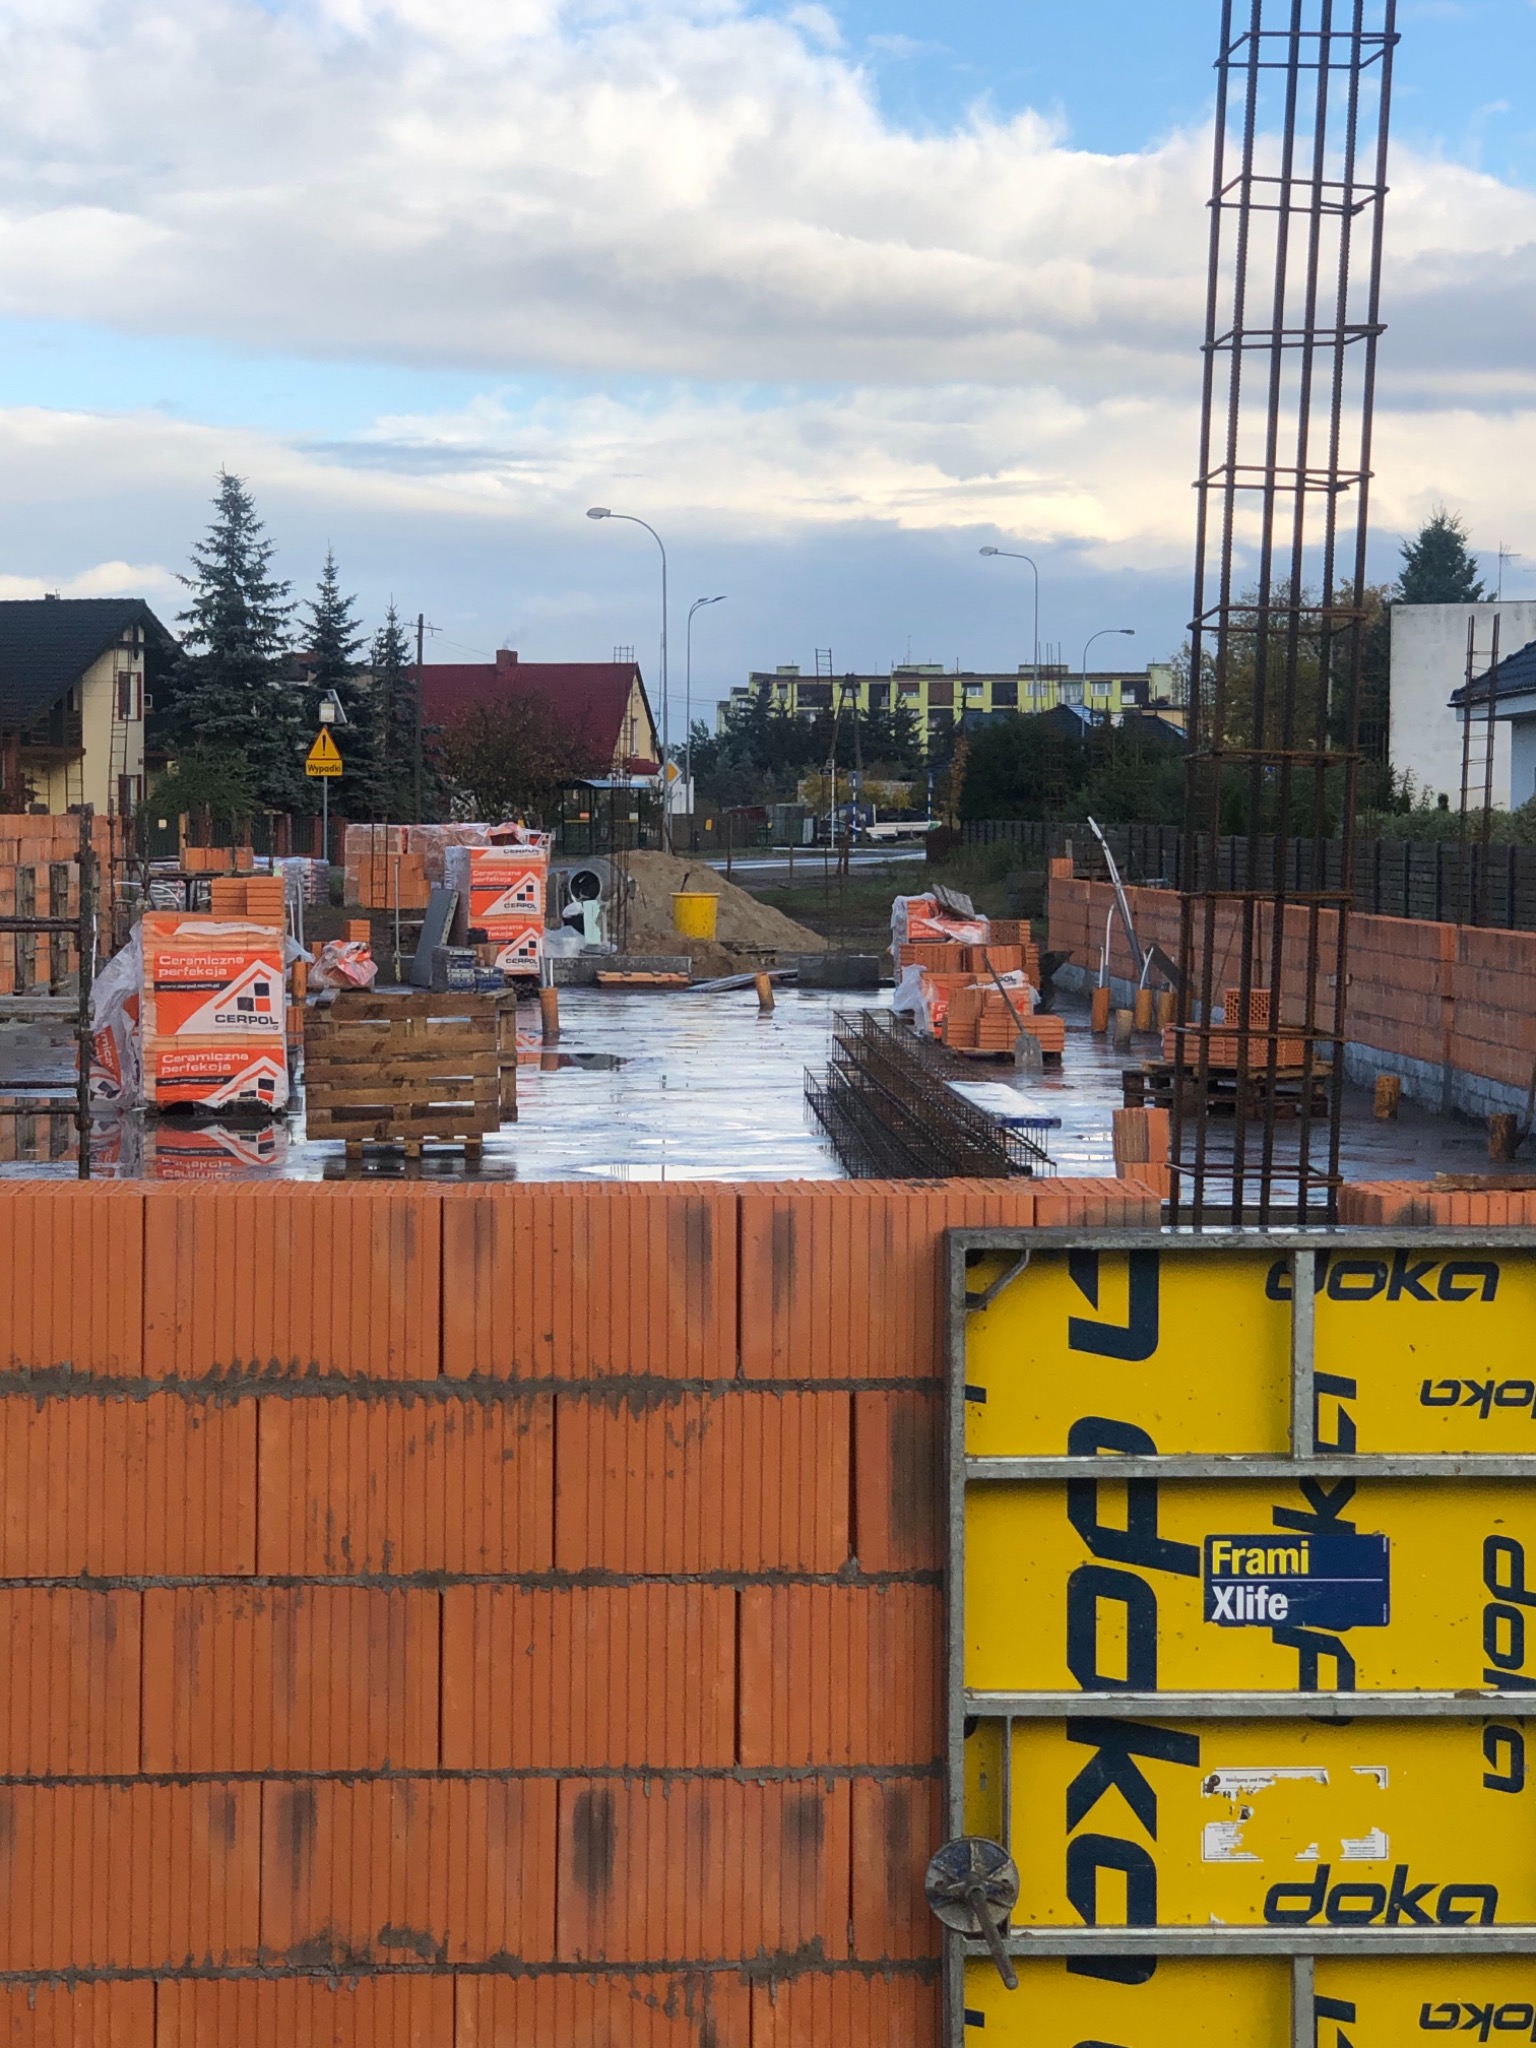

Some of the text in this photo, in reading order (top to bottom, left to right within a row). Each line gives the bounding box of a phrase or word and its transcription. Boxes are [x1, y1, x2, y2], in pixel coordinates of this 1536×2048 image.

[159, 955, 245, 966] Ceramiczna
[158, 967, 228, 978] perfekcja
[214, 1014, 279, 1025] CERPOL
[161, 1063, 232, 1074] perfekcja
[162, 1053, 249, 1064] Ceramiczna
[1420, 1379, 1536, 1419] oka
[1212, 1540, 1309, 1575] Frami
[1211, 1585, 1289, 1620] Xlife
[1264, 1864, 1498, 1923] doka
[1419, 2003, 1536, 2043] oka
